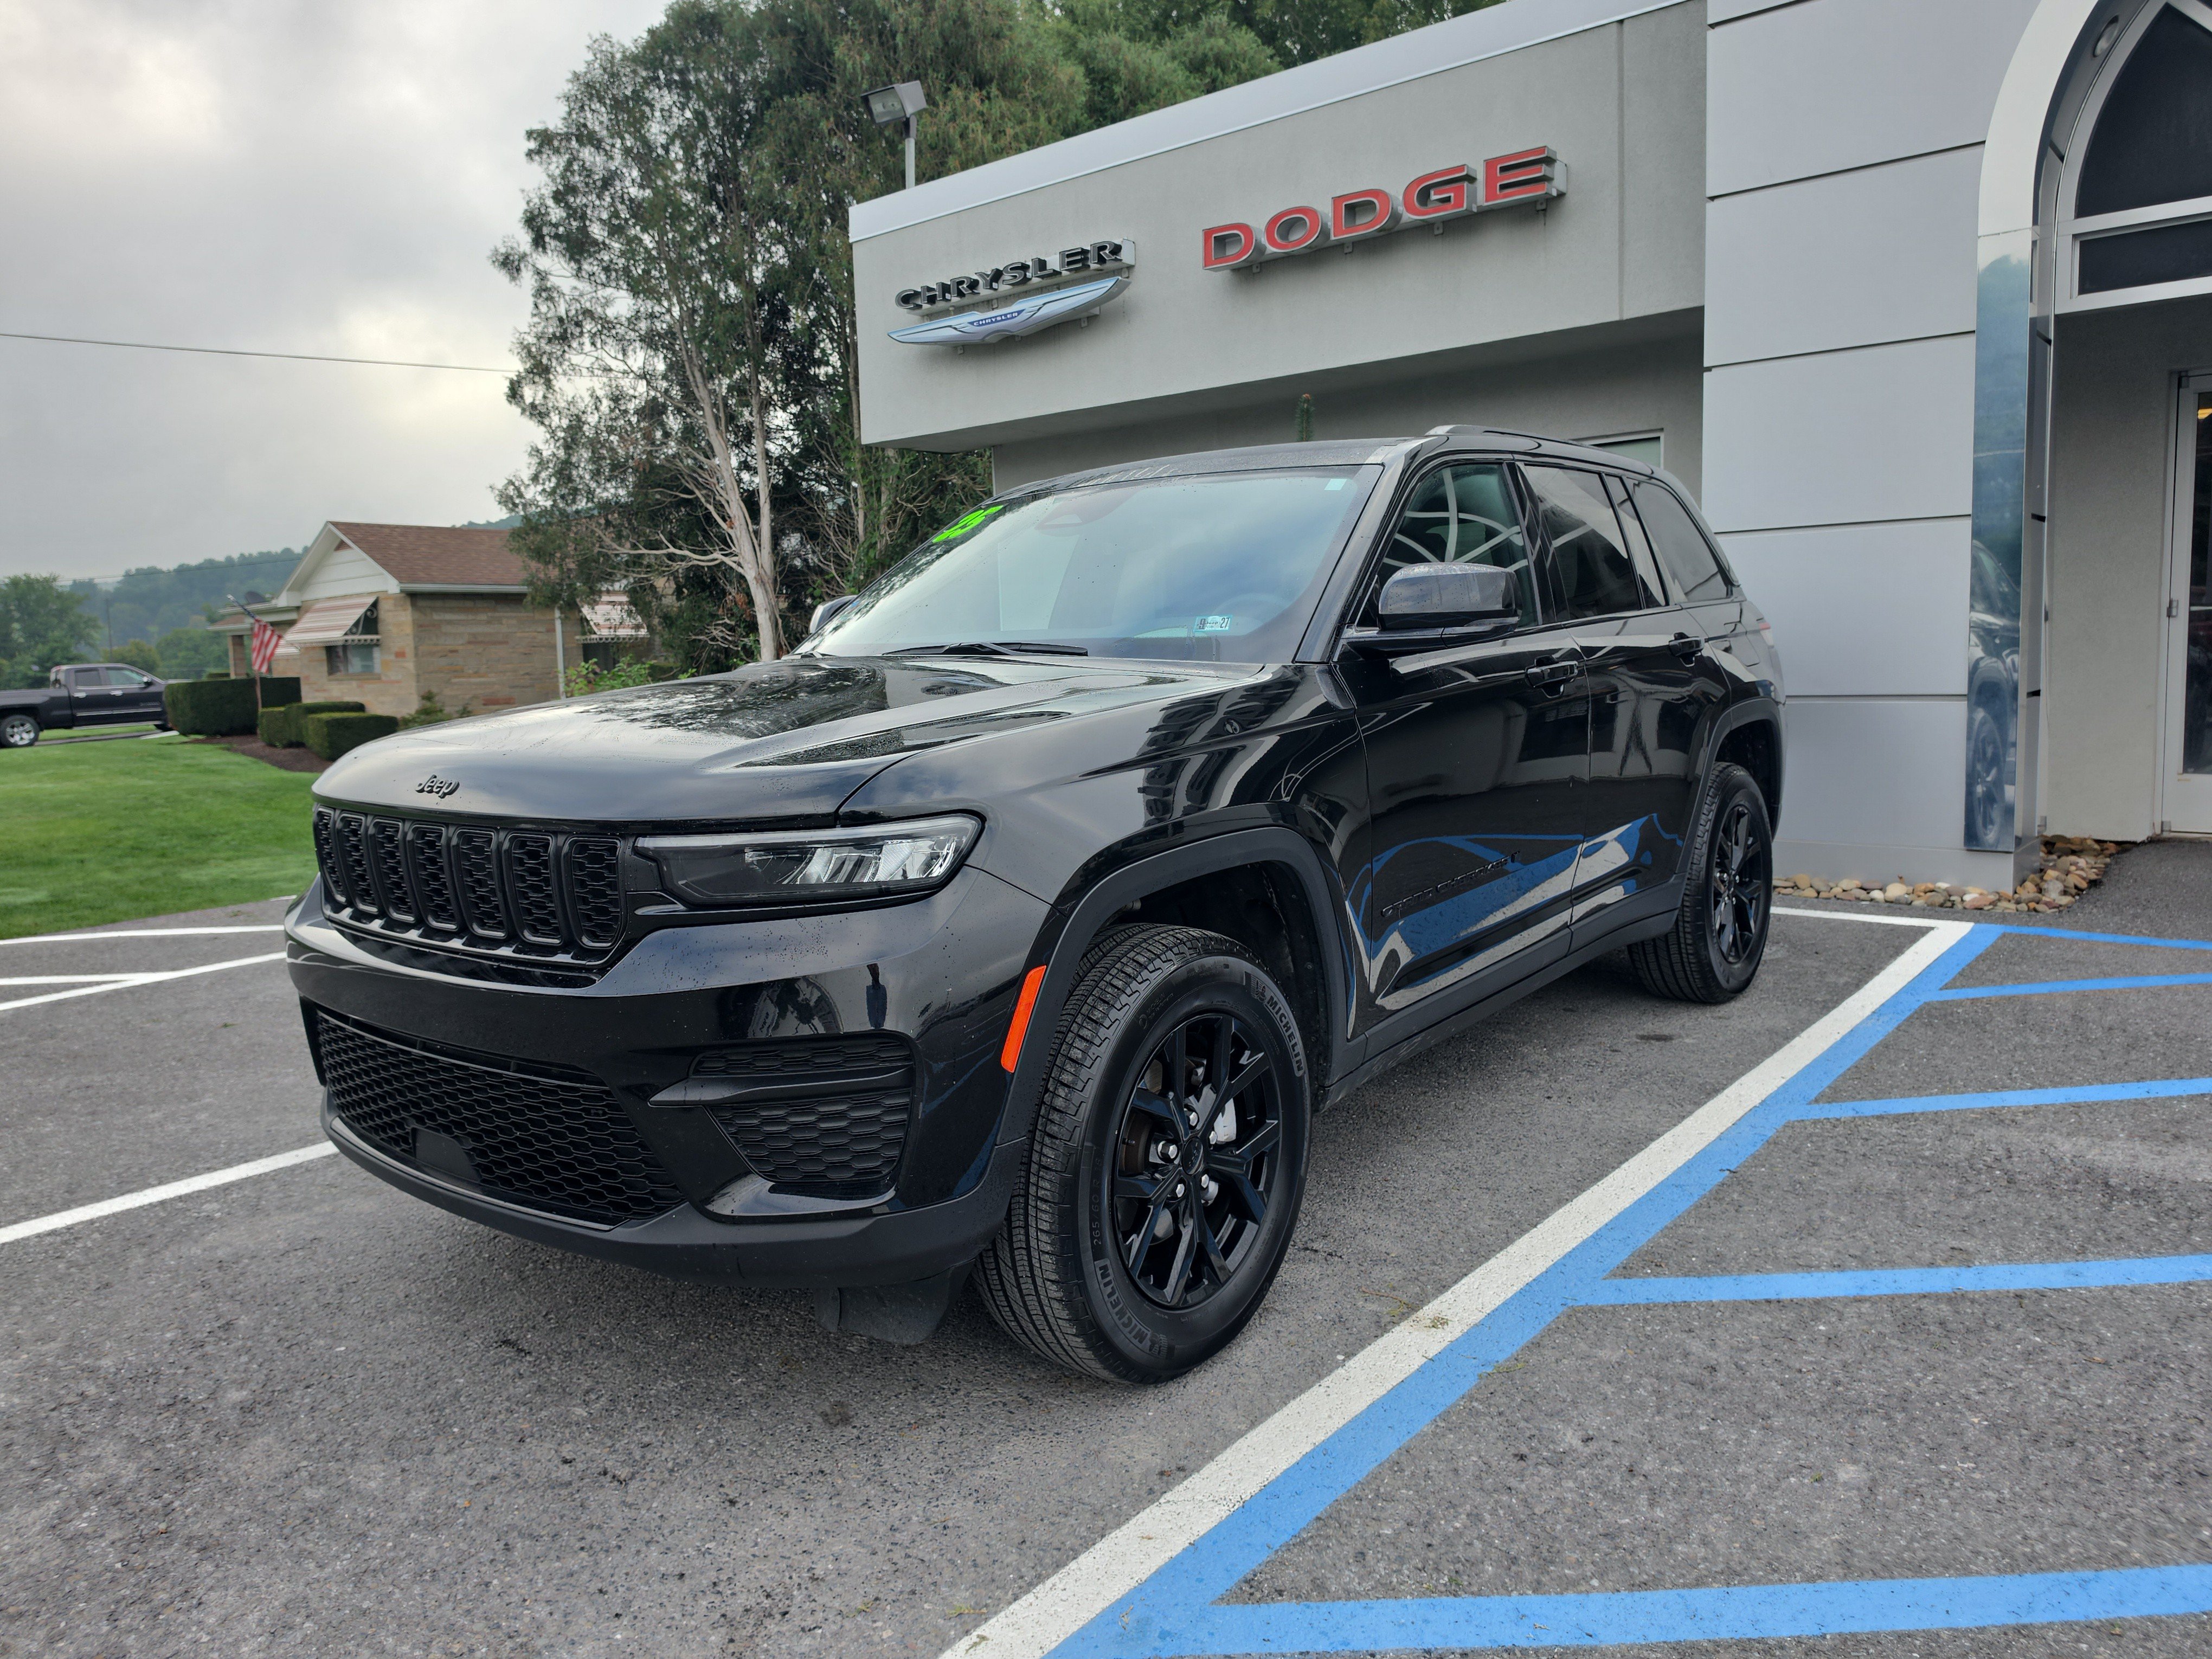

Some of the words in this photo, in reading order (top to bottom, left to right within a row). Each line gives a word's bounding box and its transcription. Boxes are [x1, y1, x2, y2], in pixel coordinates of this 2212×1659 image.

[1202, 145, 1554, 270] DODGE
[895, 240, 1123, 310] CHRYSLER
[973, 312, 1018, 326] CHRYSLER
[1219, 617, 1230, 628] 27
[415, 774, 460, 799] Jeep
[1266, 995, 1304, 1072] MICHELIN
[1091, 1193, 1102, 1246] 265/60
[1098, 1264, 1148, 1345] MICHELIN
